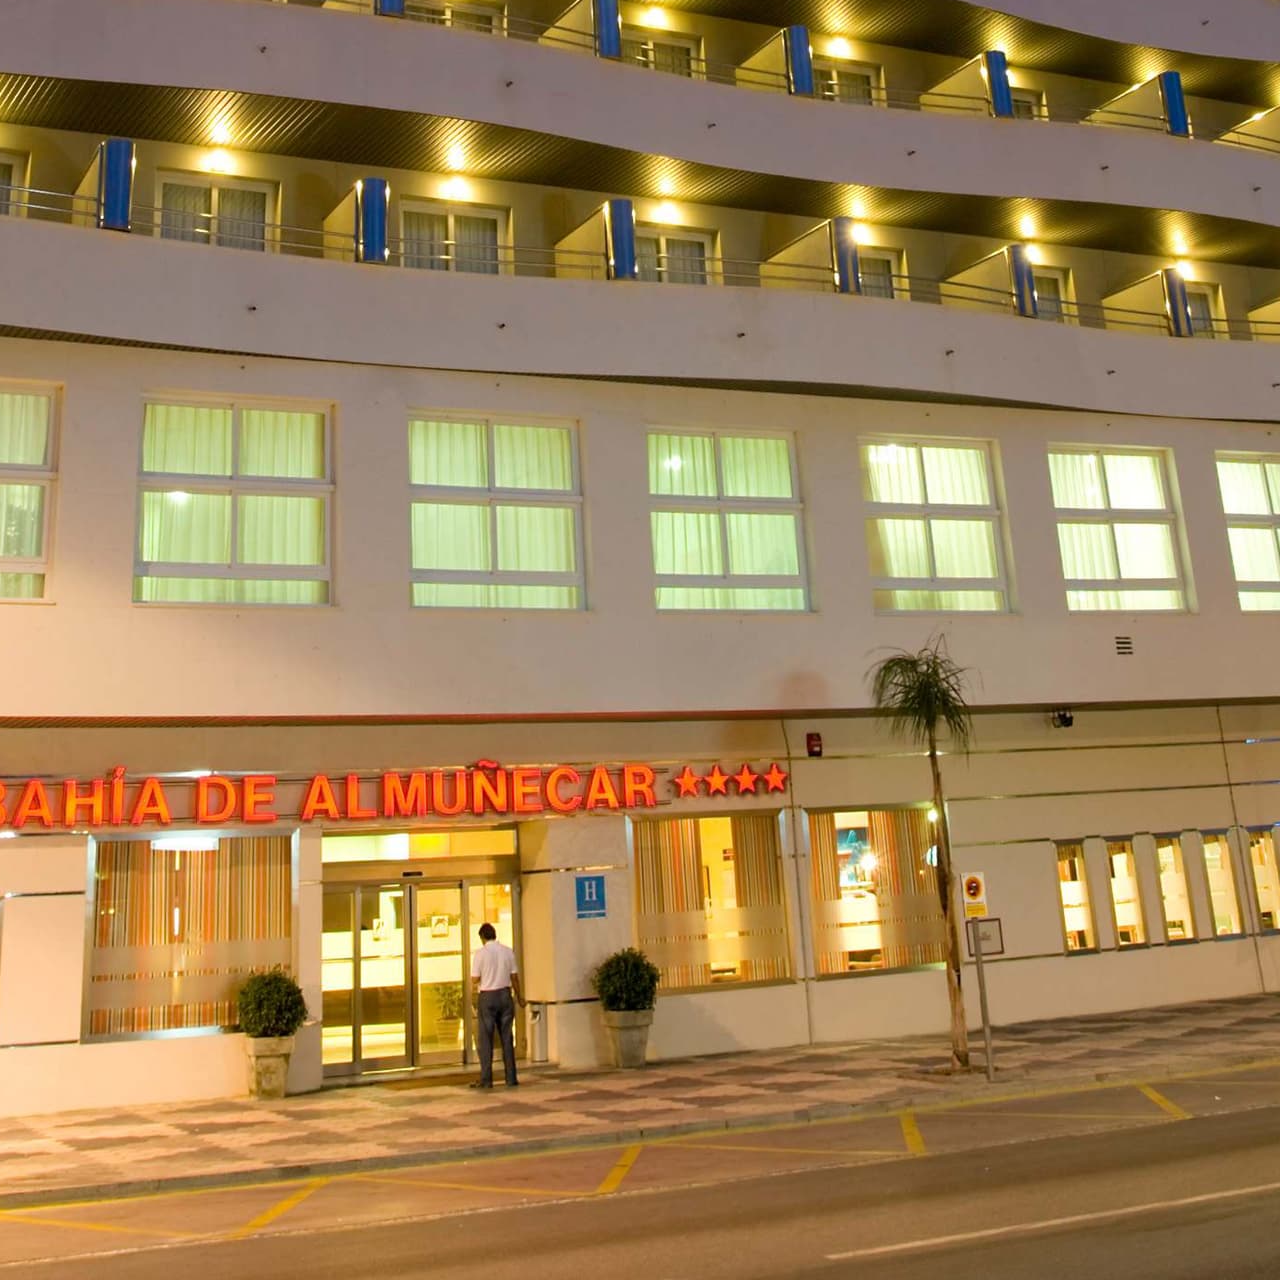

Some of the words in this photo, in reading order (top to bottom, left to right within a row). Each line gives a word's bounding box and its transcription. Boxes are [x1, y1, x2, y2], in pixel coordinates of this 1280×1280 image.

[195, 774, 277, 822] DE
[301, 758, 656, 820] ALMUÑECAR
[584, 880, 597, 901] H
